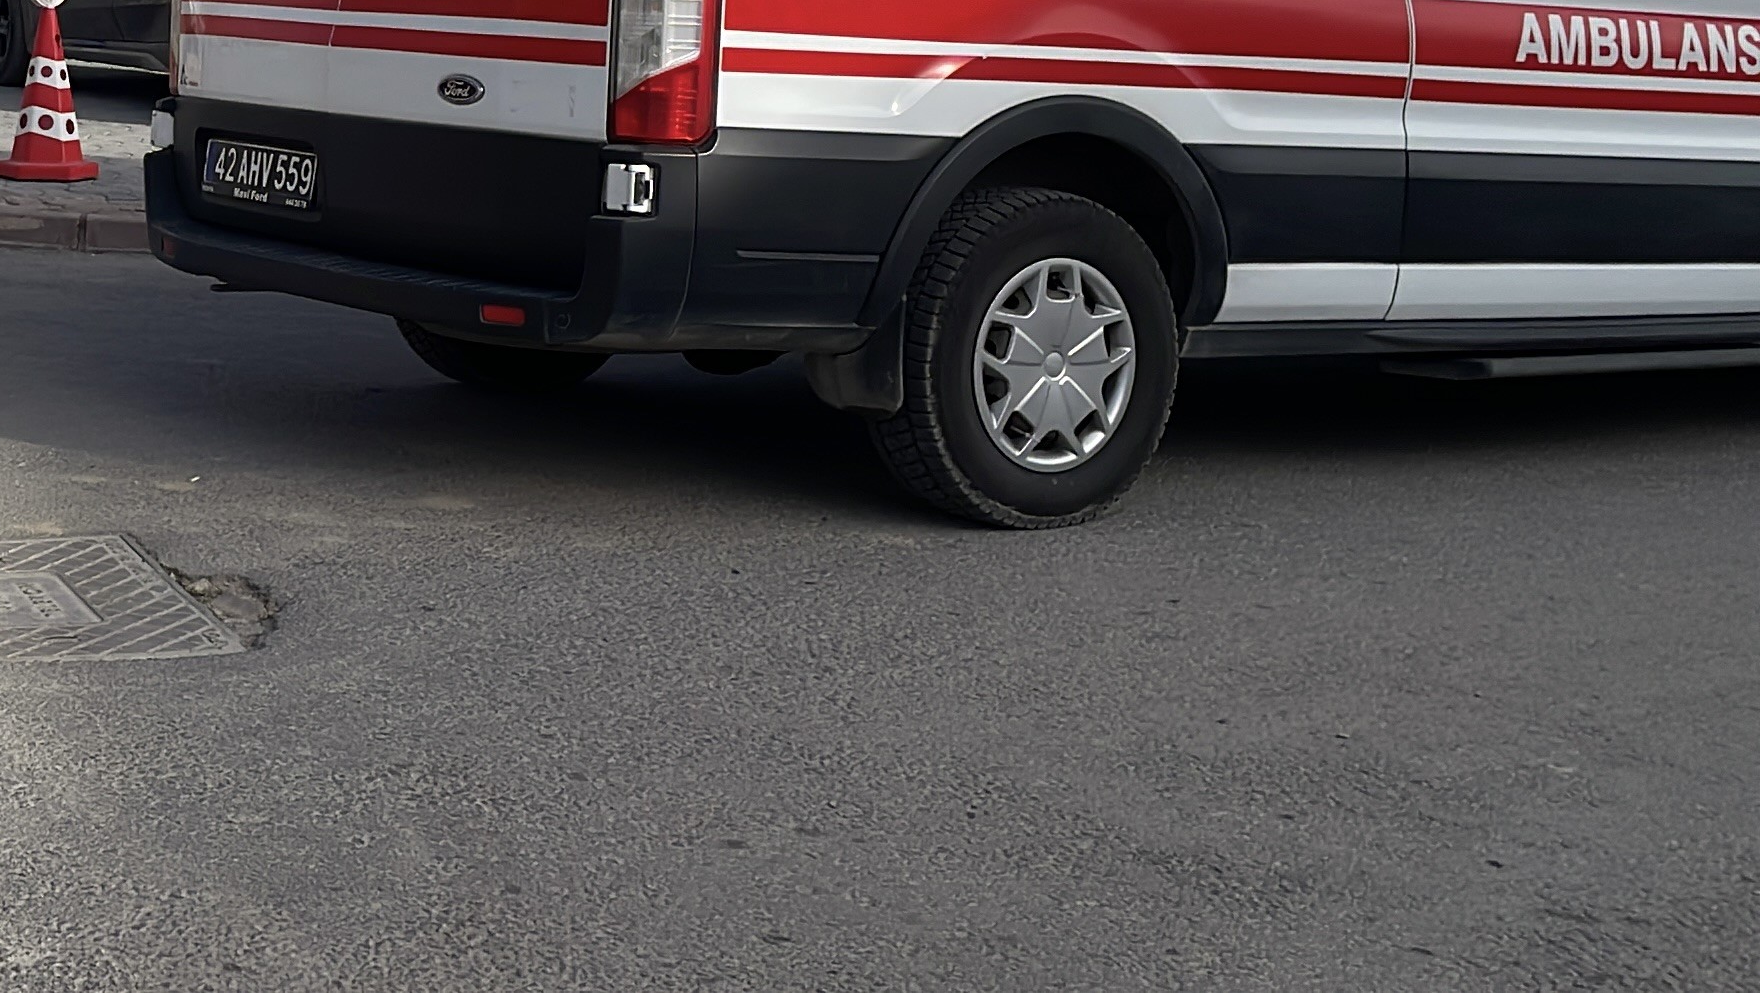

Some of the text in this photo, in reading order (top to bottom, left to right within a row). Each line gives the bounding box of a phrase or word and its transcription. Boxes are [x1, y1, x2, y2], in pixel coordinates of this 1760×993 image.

[1515, 11, 1760, 76] AMBULANS
[444, 79, 470, 98] Ford
[215, 147, 313, 195] 42 AHV 559
